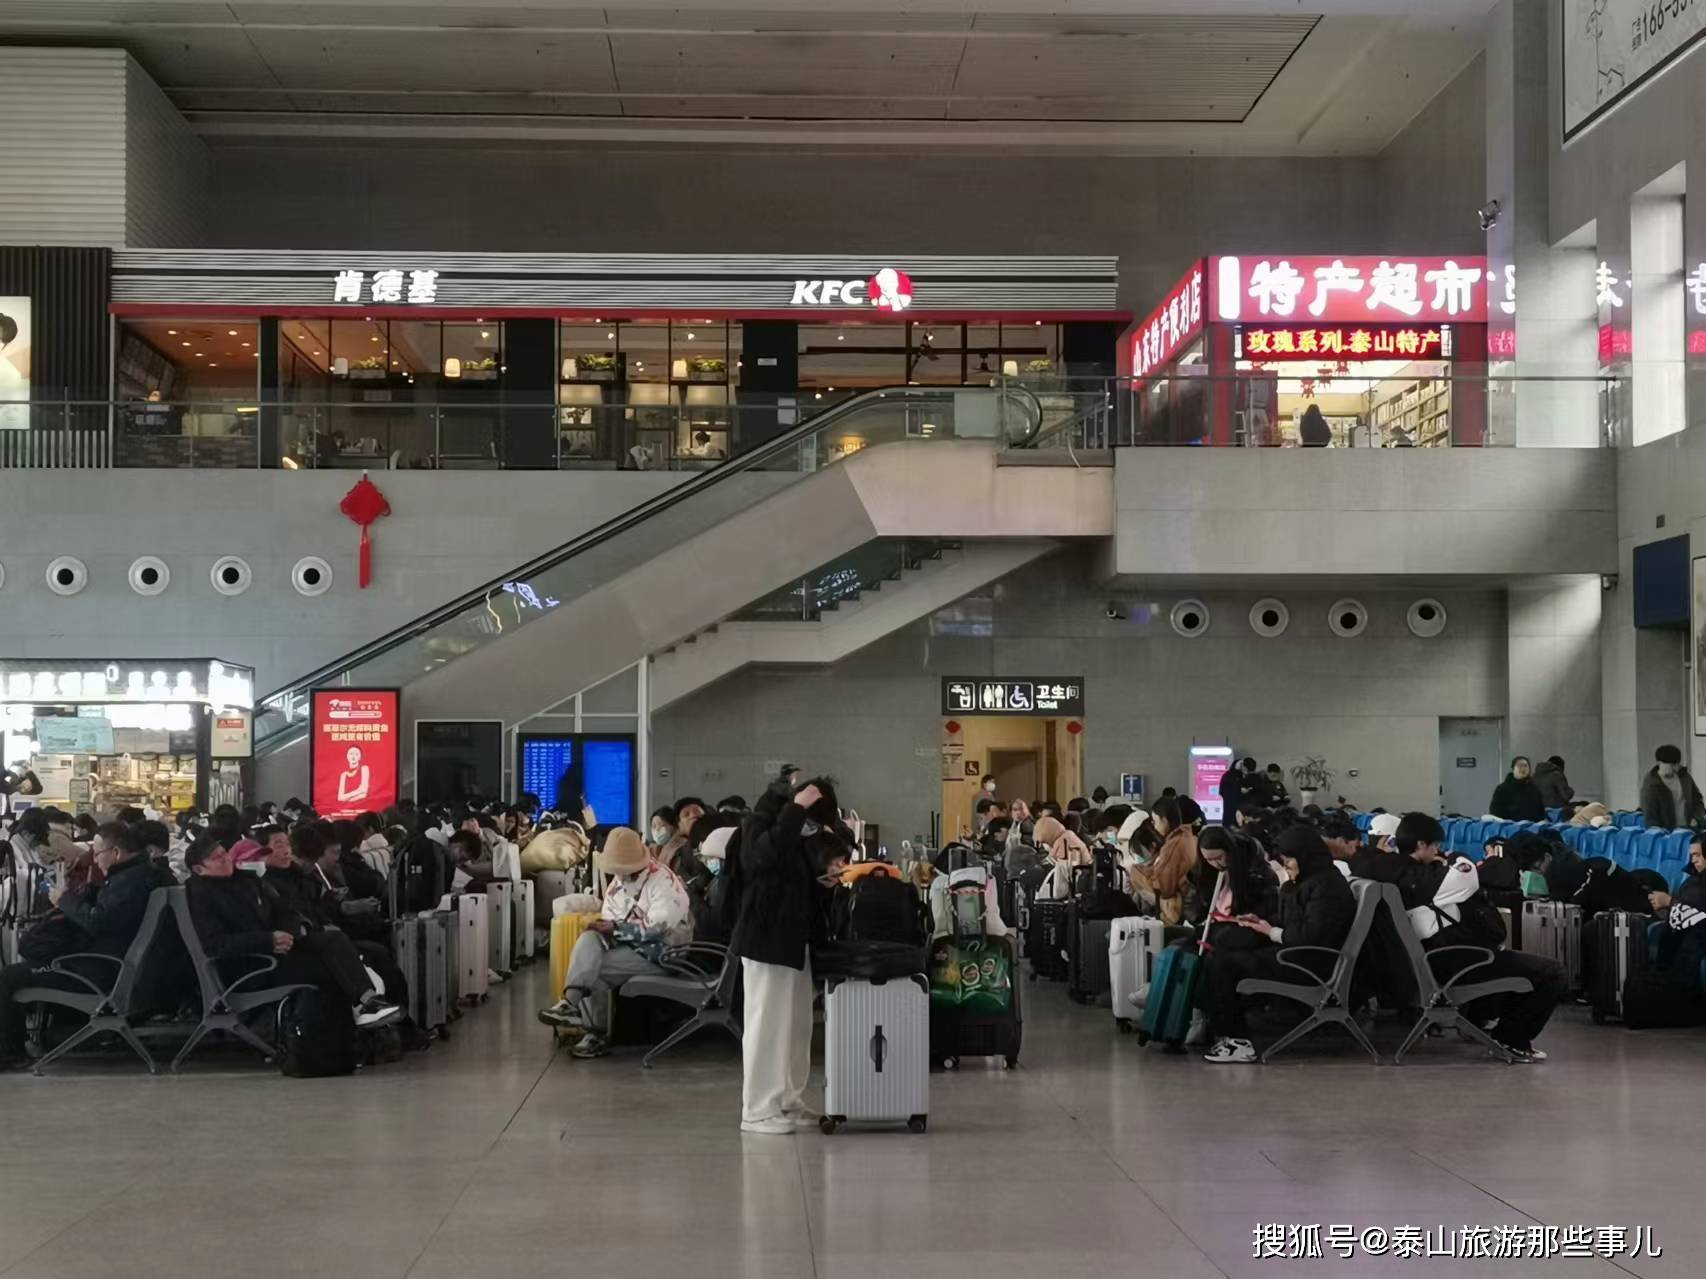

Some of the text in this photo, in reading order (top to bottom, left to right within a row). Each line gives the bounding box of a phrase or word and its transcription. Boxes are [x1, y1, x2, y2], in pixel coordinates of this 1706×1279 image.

[334, 269, 439, 303] 肯德基
[790, 280, 865, 305] KFC
[1248, 259, 1482, 317] 特产超市
[1035, 684, 1080, 700] 卫生间
